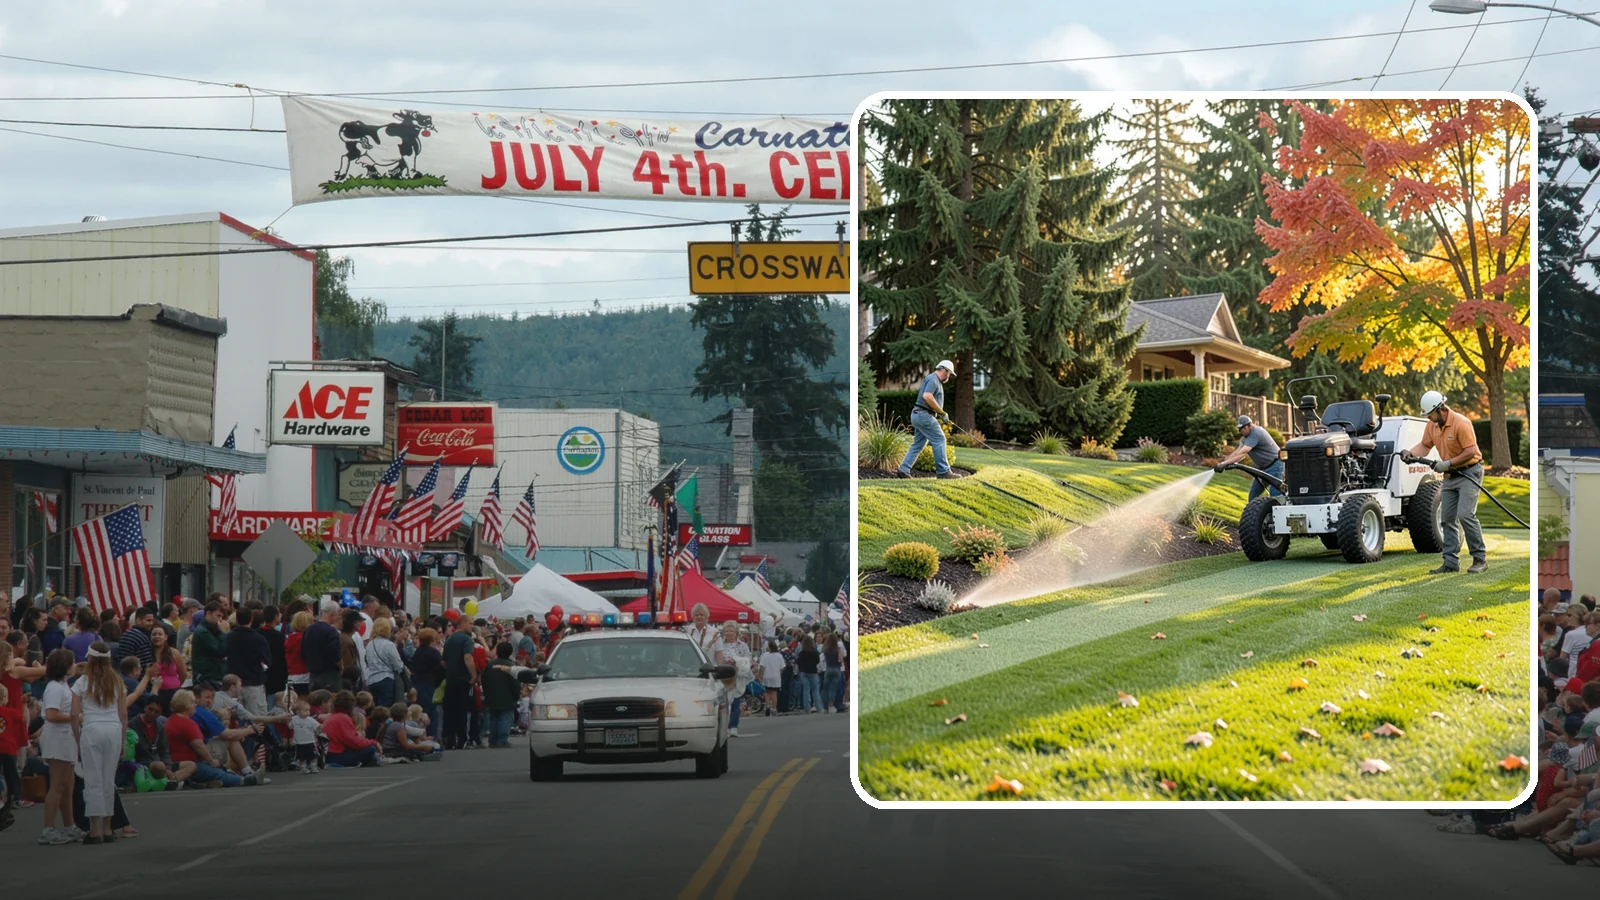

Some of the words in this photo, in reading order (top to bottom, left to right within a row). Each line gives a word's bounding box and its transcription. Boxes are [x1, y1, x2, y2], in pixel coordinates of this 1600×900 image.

[695, 121, 850, 150] Carnat
[481, 141, 605, 192] JULY
[632, 151, 746, 198] 4th.
[697, 254, 850, 280] CROSSWA
[283, 380, 373, 420] ACE
[406, 409, 452, 422] CEDAR
[461, 409, 485, 421] LOG
[284, 421, 370, 436] Hardware
[417, 428, 476, 447] Coca-Cola
[354, 467, 385, 480] Simpl
[83, 485, 93, 494] St.
[96, 485, 124, 495] Vincent
[126, 486, 135, 494] de
[138, 486, 155, 495] Paul
[688, 526, 741, 535] CRNATION
[699, 535, 730, 543] GLASS
